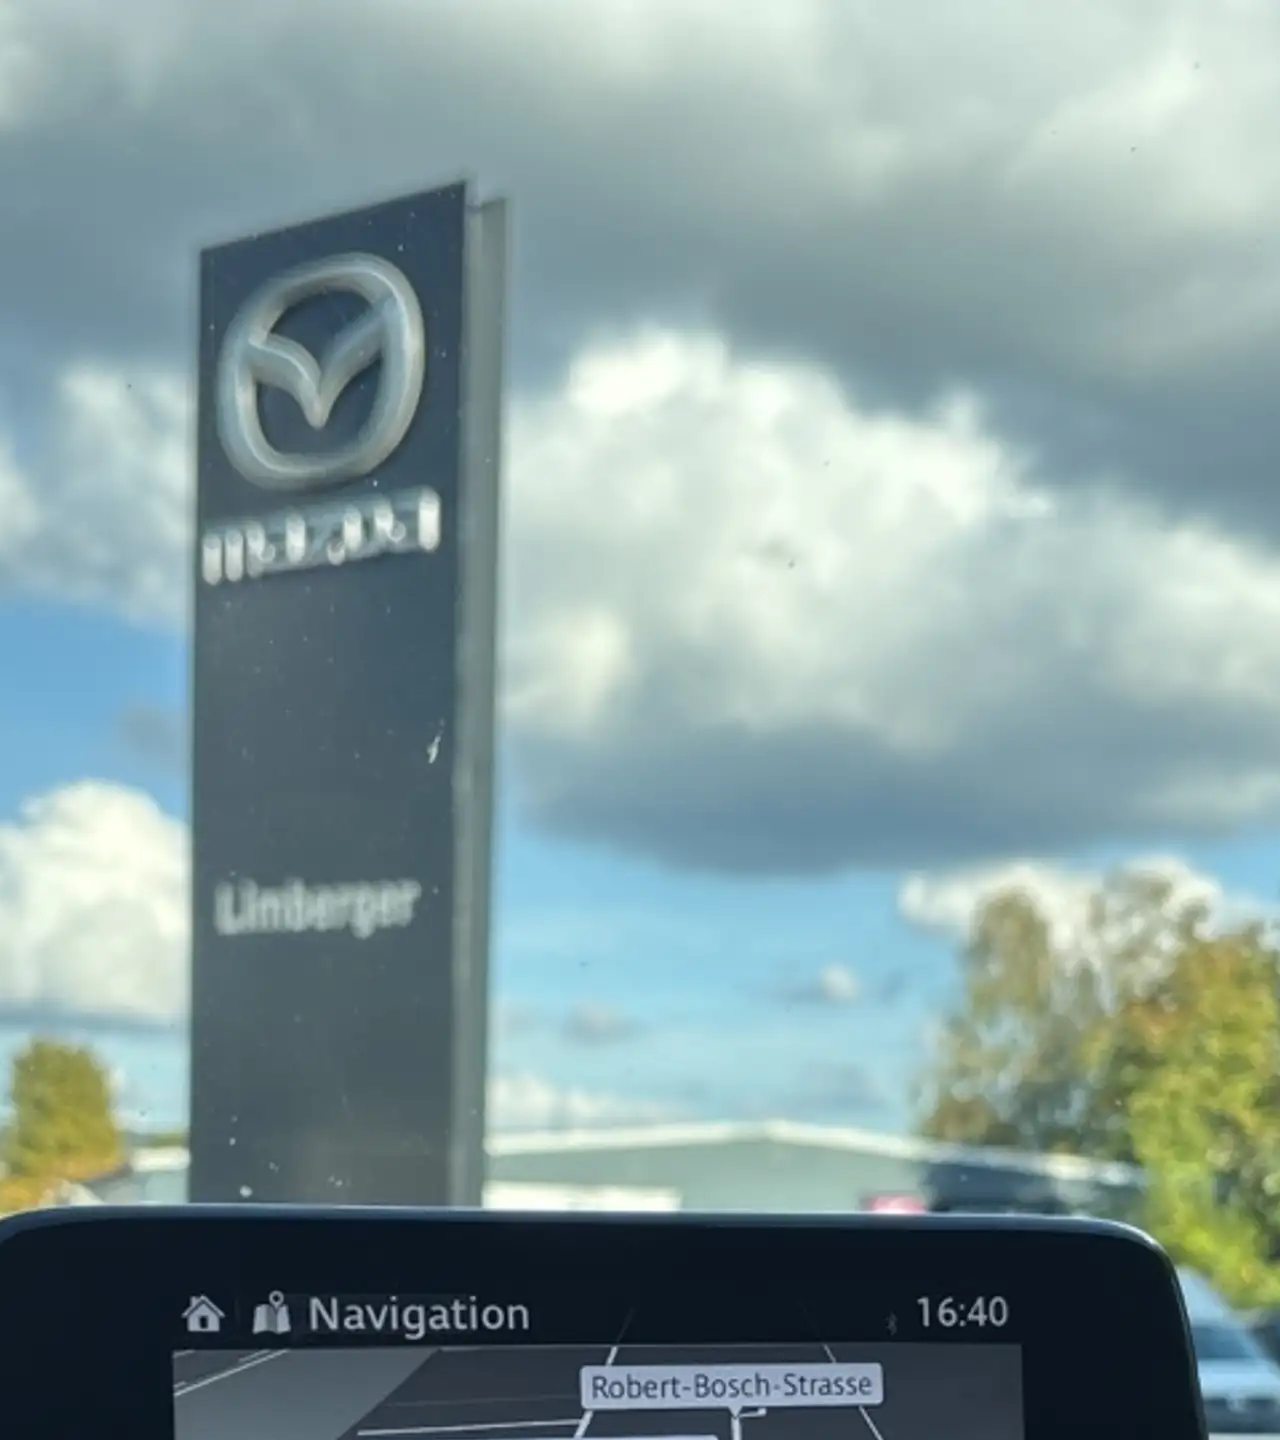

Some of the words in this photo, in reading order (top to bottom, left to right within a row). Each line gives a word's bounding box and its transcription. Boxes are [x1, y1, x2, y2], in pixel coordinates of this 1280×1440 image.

[309, 1295, 529, 1340] Navigation
[917, 1296, 1009, 1327] 16:40
[592, 1372, 873, 1400] Robert-Bosch-Strasse
